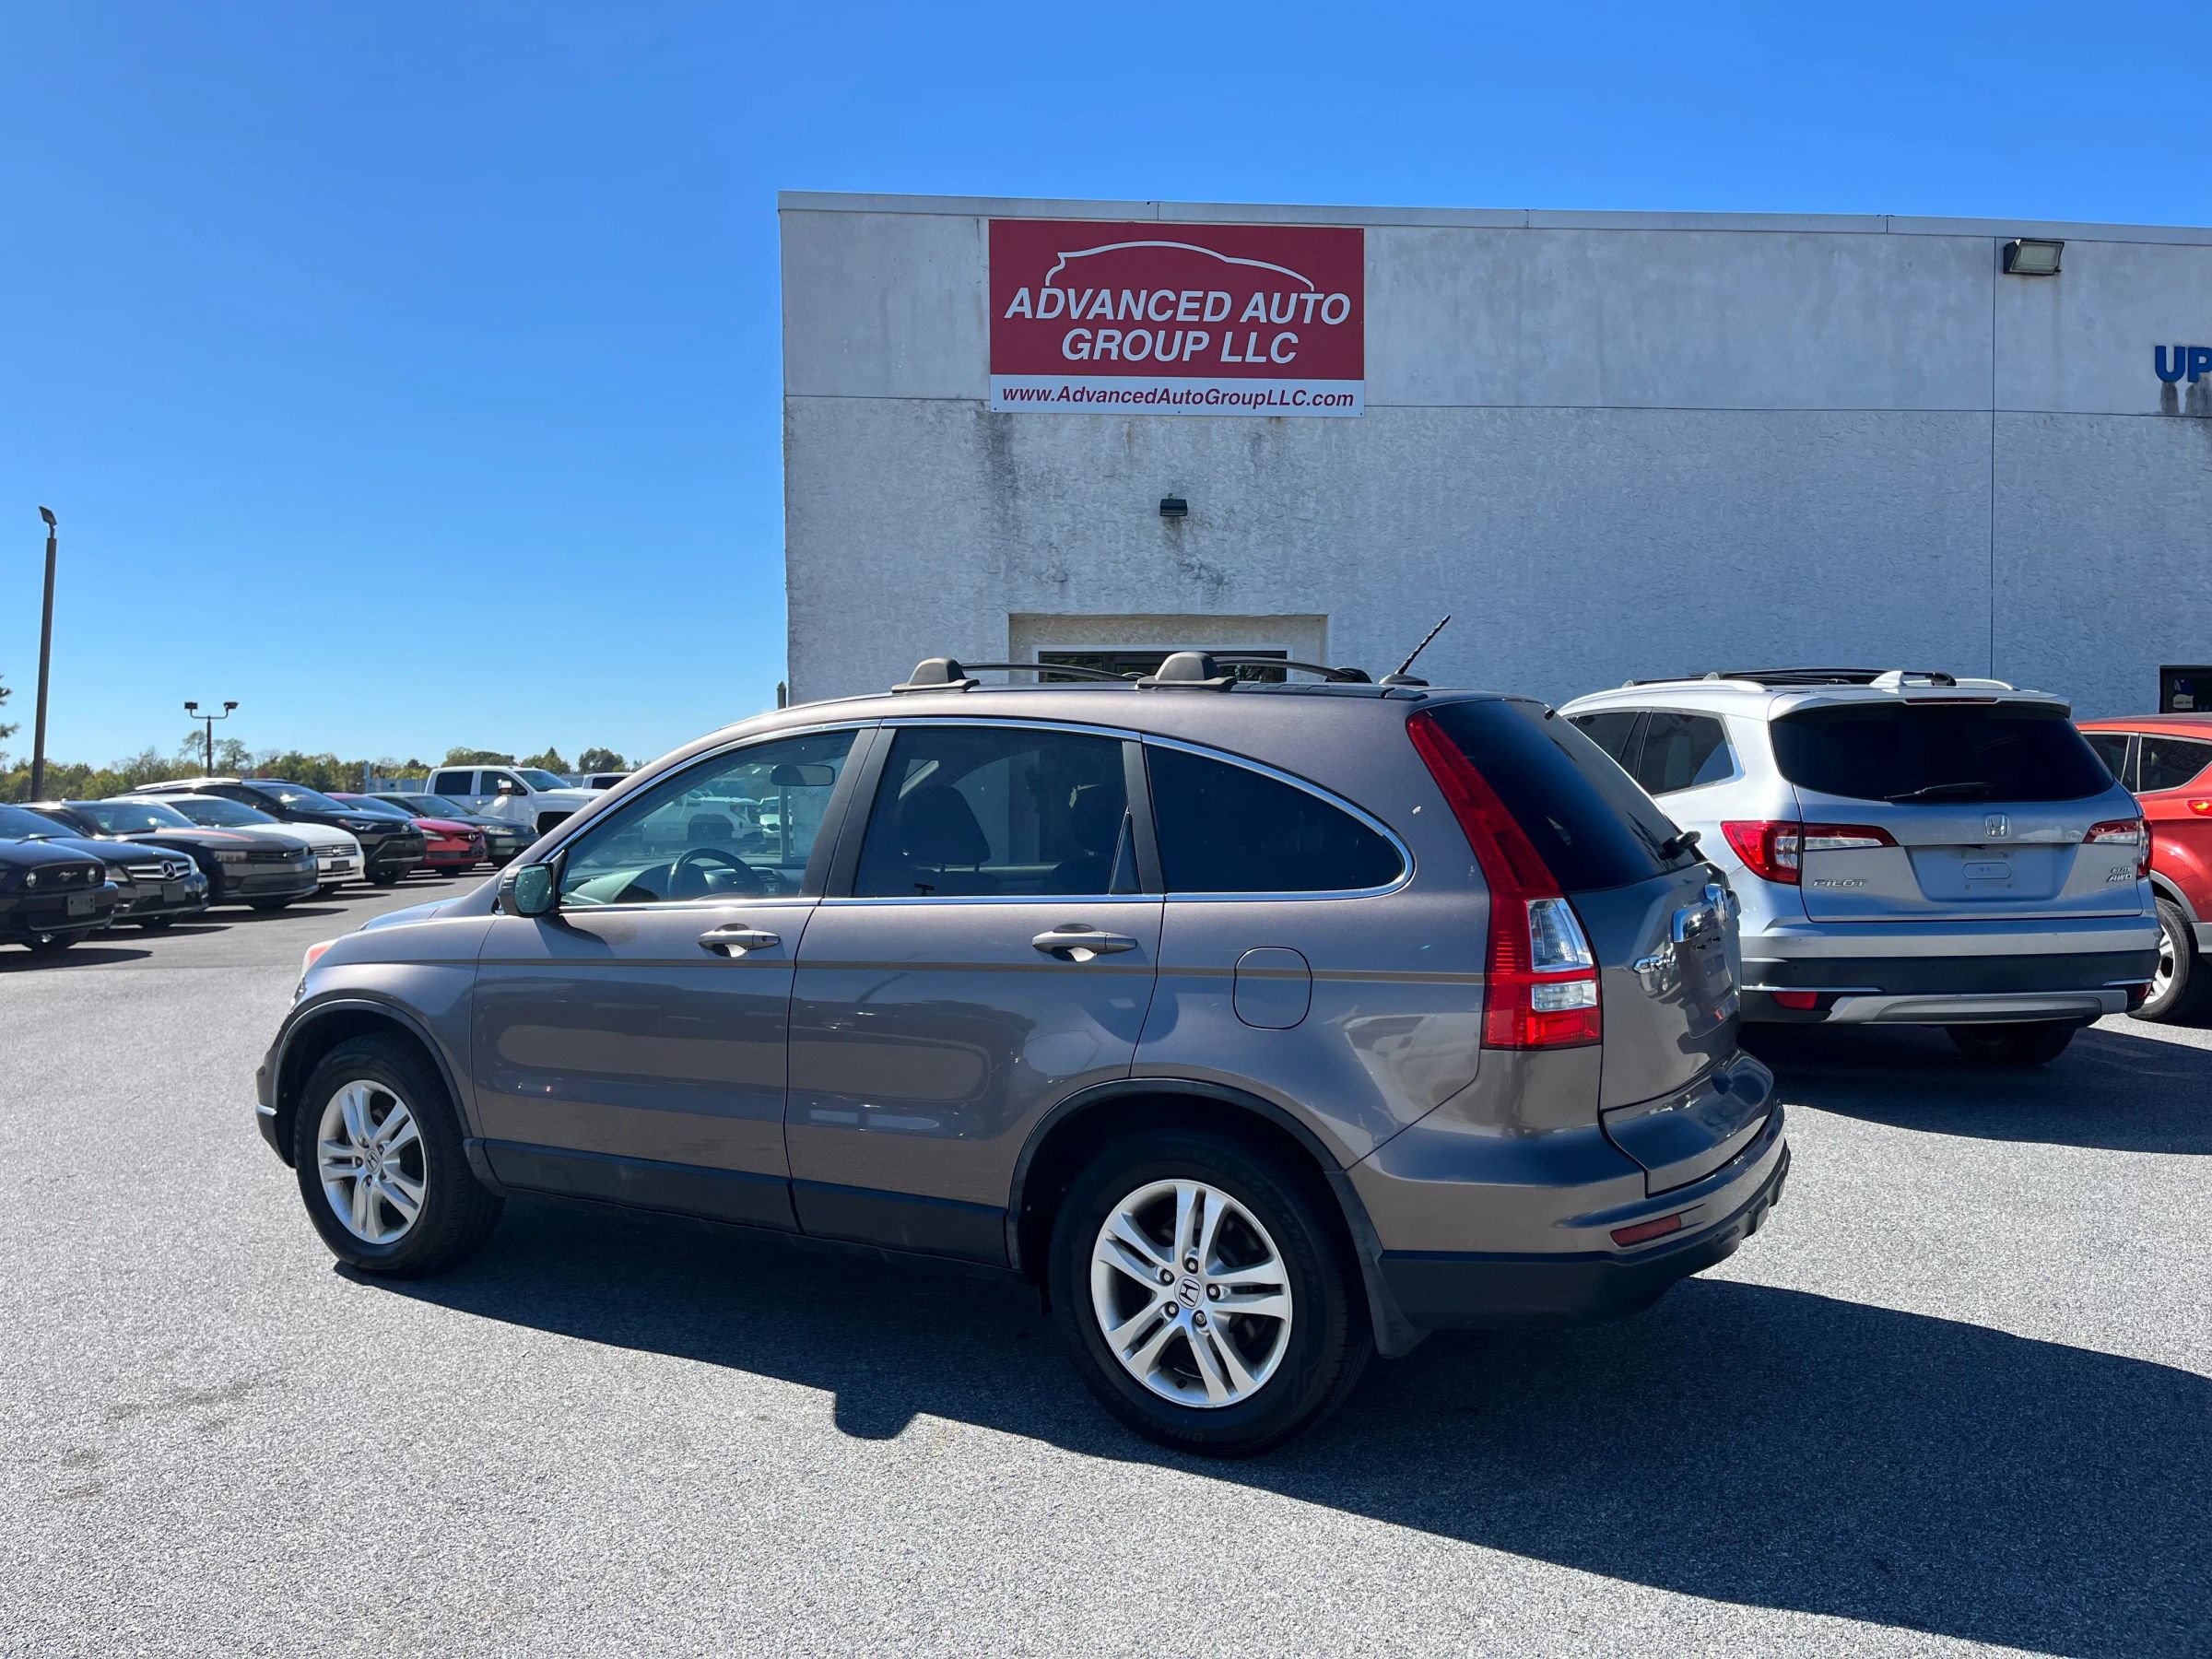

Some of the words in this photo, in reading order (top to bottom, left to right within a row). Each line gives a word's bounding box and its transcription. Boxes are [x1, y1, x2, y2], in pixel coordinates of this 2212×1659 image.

[1003, 287, 1233, 323] ADVANCED
[1239, 291, 1351, 325] AUTO
[1062, 327, 1210, 362] GROUP
[1219, 331, 1300, 364] LLC
[2154, 345, 2212, 383] UP
[1002, 385, 1354, 410] www.AdvancedAutoGroupLLC.com
[1812, 878, 1868, 888] PILOT
[2106, 873, 2133, 882] AWD
